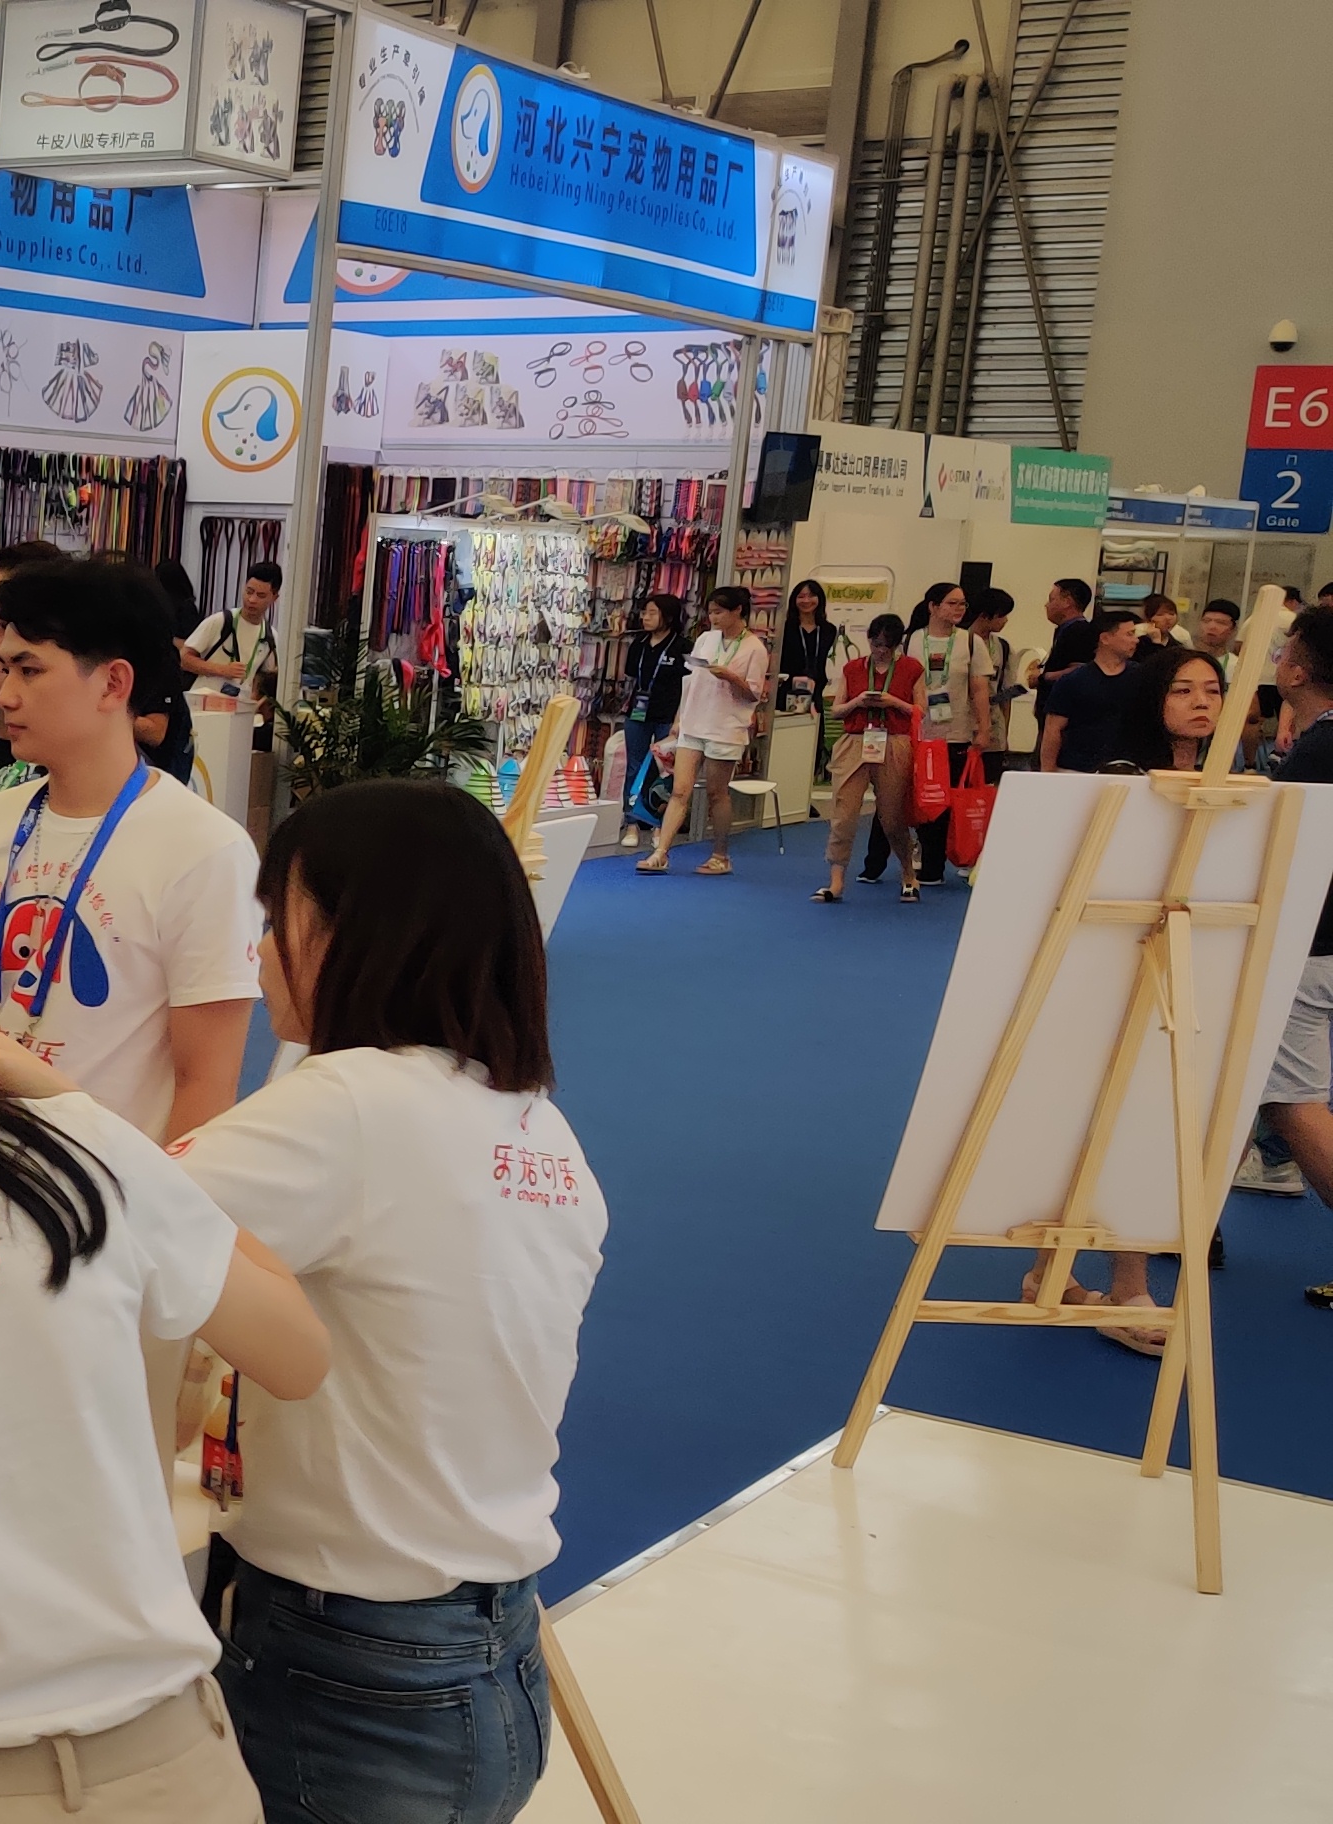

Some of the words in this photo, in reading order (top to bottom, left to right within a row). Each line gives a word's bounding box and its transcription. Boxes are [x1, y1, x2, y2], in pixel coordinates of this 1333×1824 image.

[36, 131, 155, 150] 牛皮八股专利产品
[513, 96, 744, 209] 河北兴宁宠物用品厂
[510, 163, 550, 194] Hebei
[552, 173, 581, 206] Xing
[585, 181, 614, 214] Ning
[618, 190, 637, 213] Pet
[639, 197, 690, 227] Supplies
[117, 251, 148, 275] Ltd.
[1264, 386, 1330, 428] E6
[1270, 470, 1302, 509] 2
[1266, 515, 1300, 528] Gate
